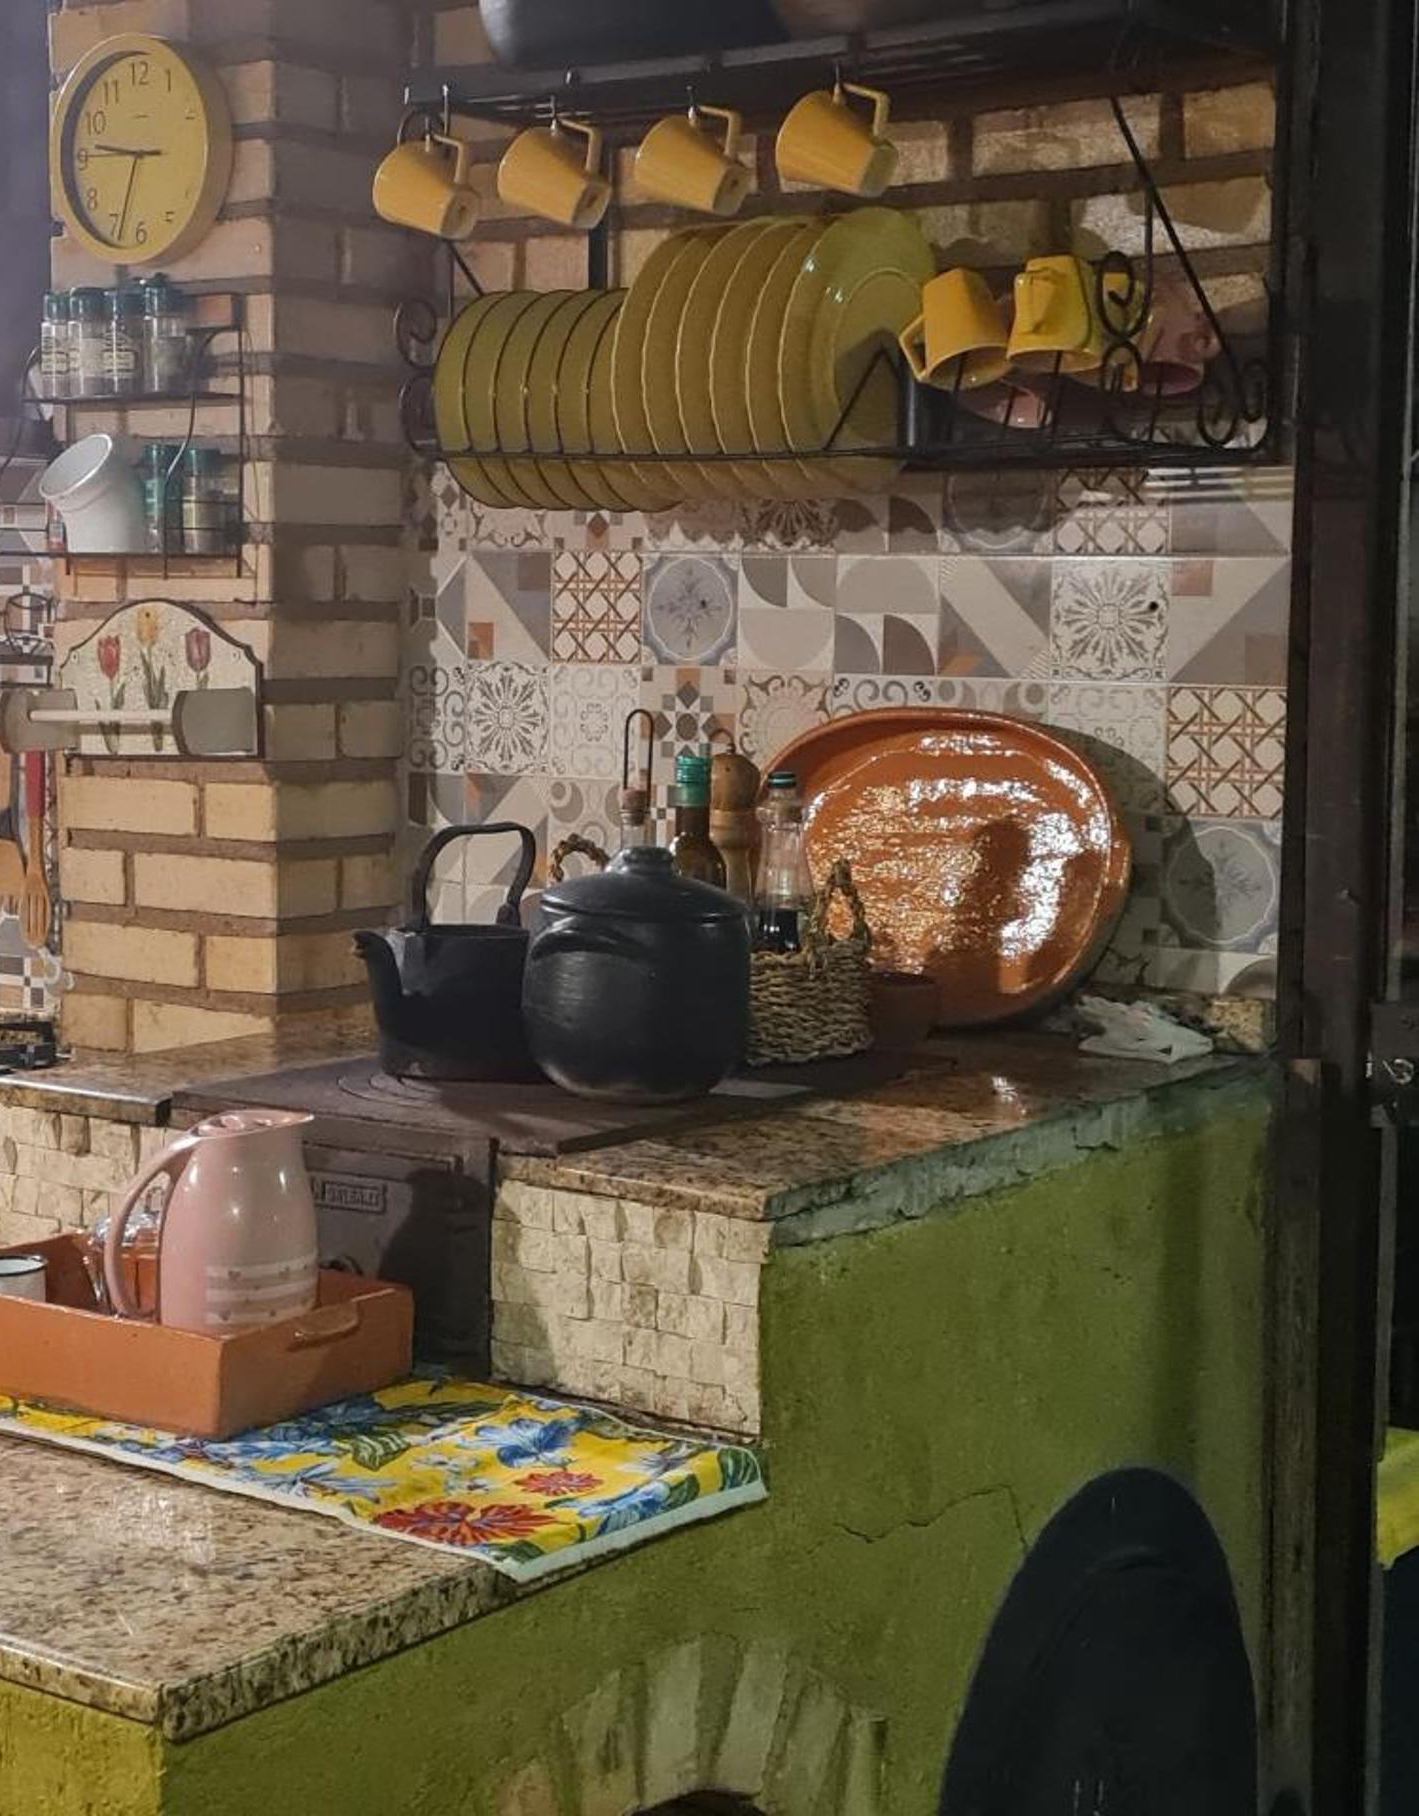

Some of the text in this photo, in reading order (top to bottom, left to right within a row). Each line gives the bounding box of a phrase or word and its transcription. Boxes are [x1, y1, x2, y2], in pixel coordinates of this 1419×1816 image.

[130, 61, 149, 87] 12
[165, 68, 172, 92] 1
[103, 79, 119, 106] 11
[85, 110, 106, 136] 10
[77, 149, 88, 171] 9
[86, 187, 98, 211] 8
[109, 213, 118, 237] 7
[135, 221, 147, 245] 6
